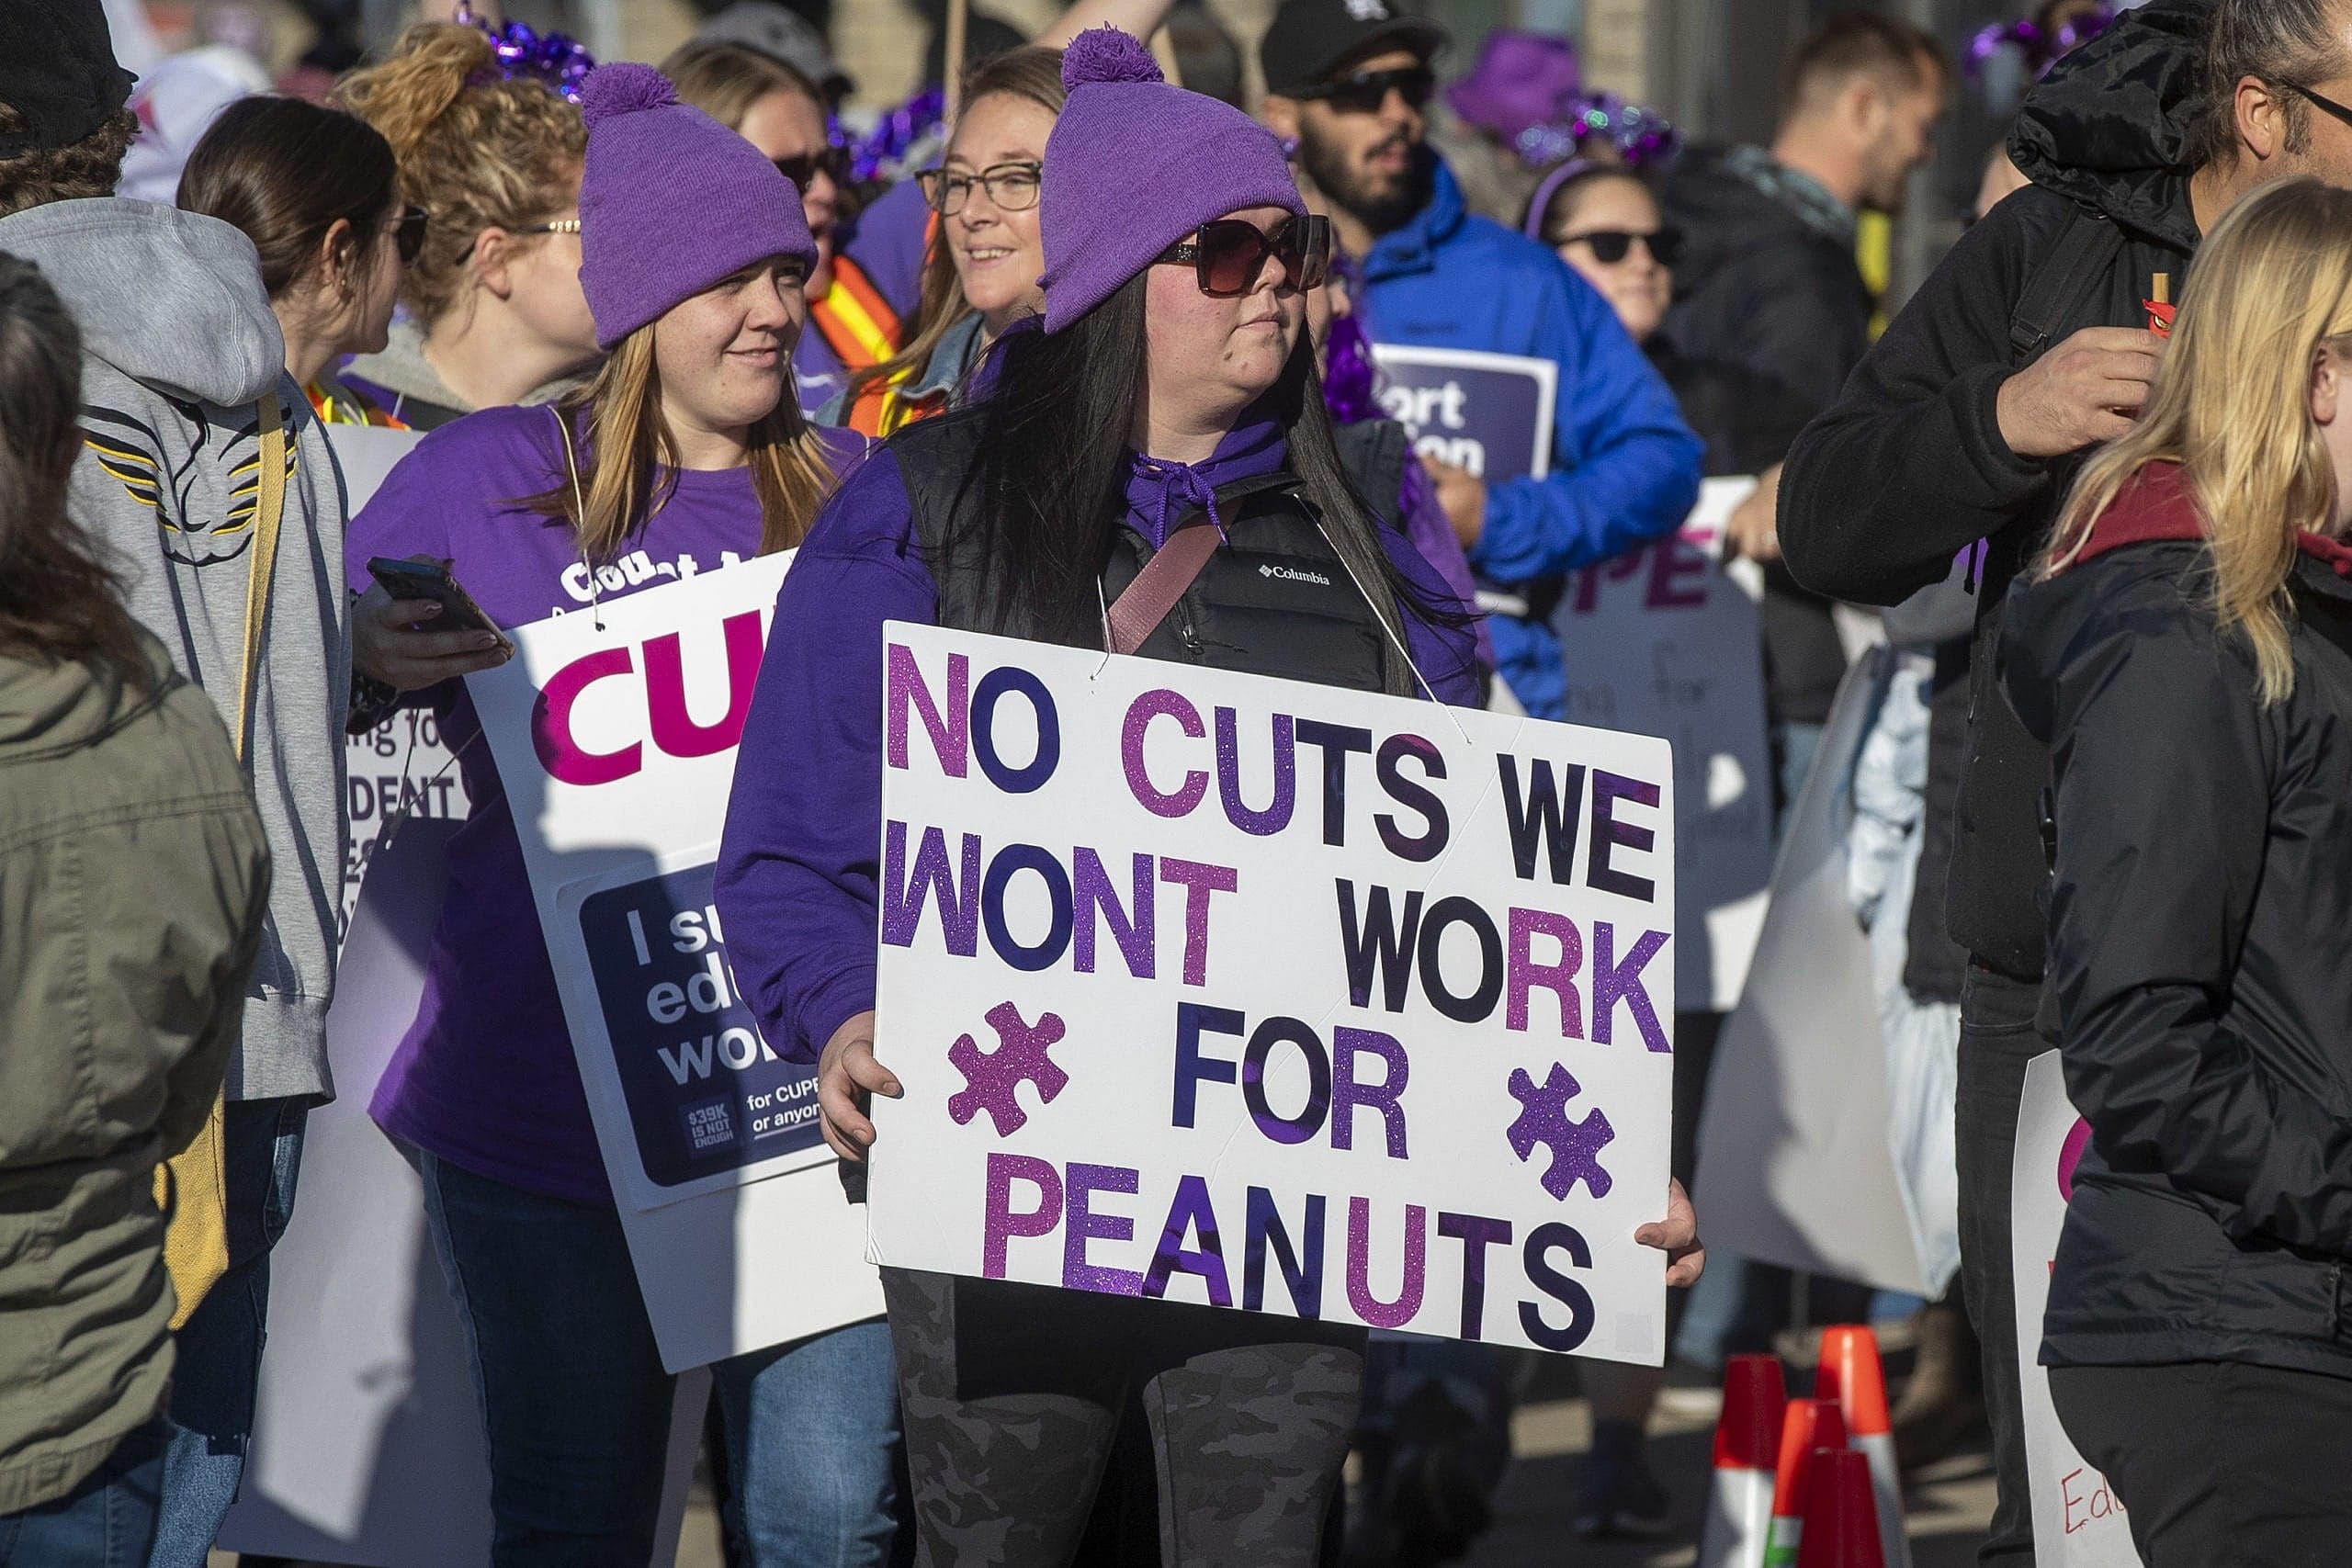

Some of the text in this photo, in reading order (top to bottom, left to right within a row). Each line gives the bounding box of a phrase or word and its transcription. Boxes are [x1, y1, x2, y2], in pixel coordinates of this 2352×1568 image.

[1272, 566, 1330, 585] Columbia
[531, 604, 776, 786] CU
[888, 642, 1661, 903] NO CUTS WE
[627, 909, 651, 965] I
[881, 819, 1673, 1054] WONT WORK
[647, 951, 741, 1024] ed
[746, 1094, 772, 1111] for
[1171, 1001, 1409, 1160] FOR
[689, 1103, 729, 1125] $39K
[692, 1118, 730, 1138] IS NOT
[695, 1130, 734, 1149] ENOUGH
[752, 1115, 772, 1132] or
[982, 1153, 1596, 1352] PEANUTS
